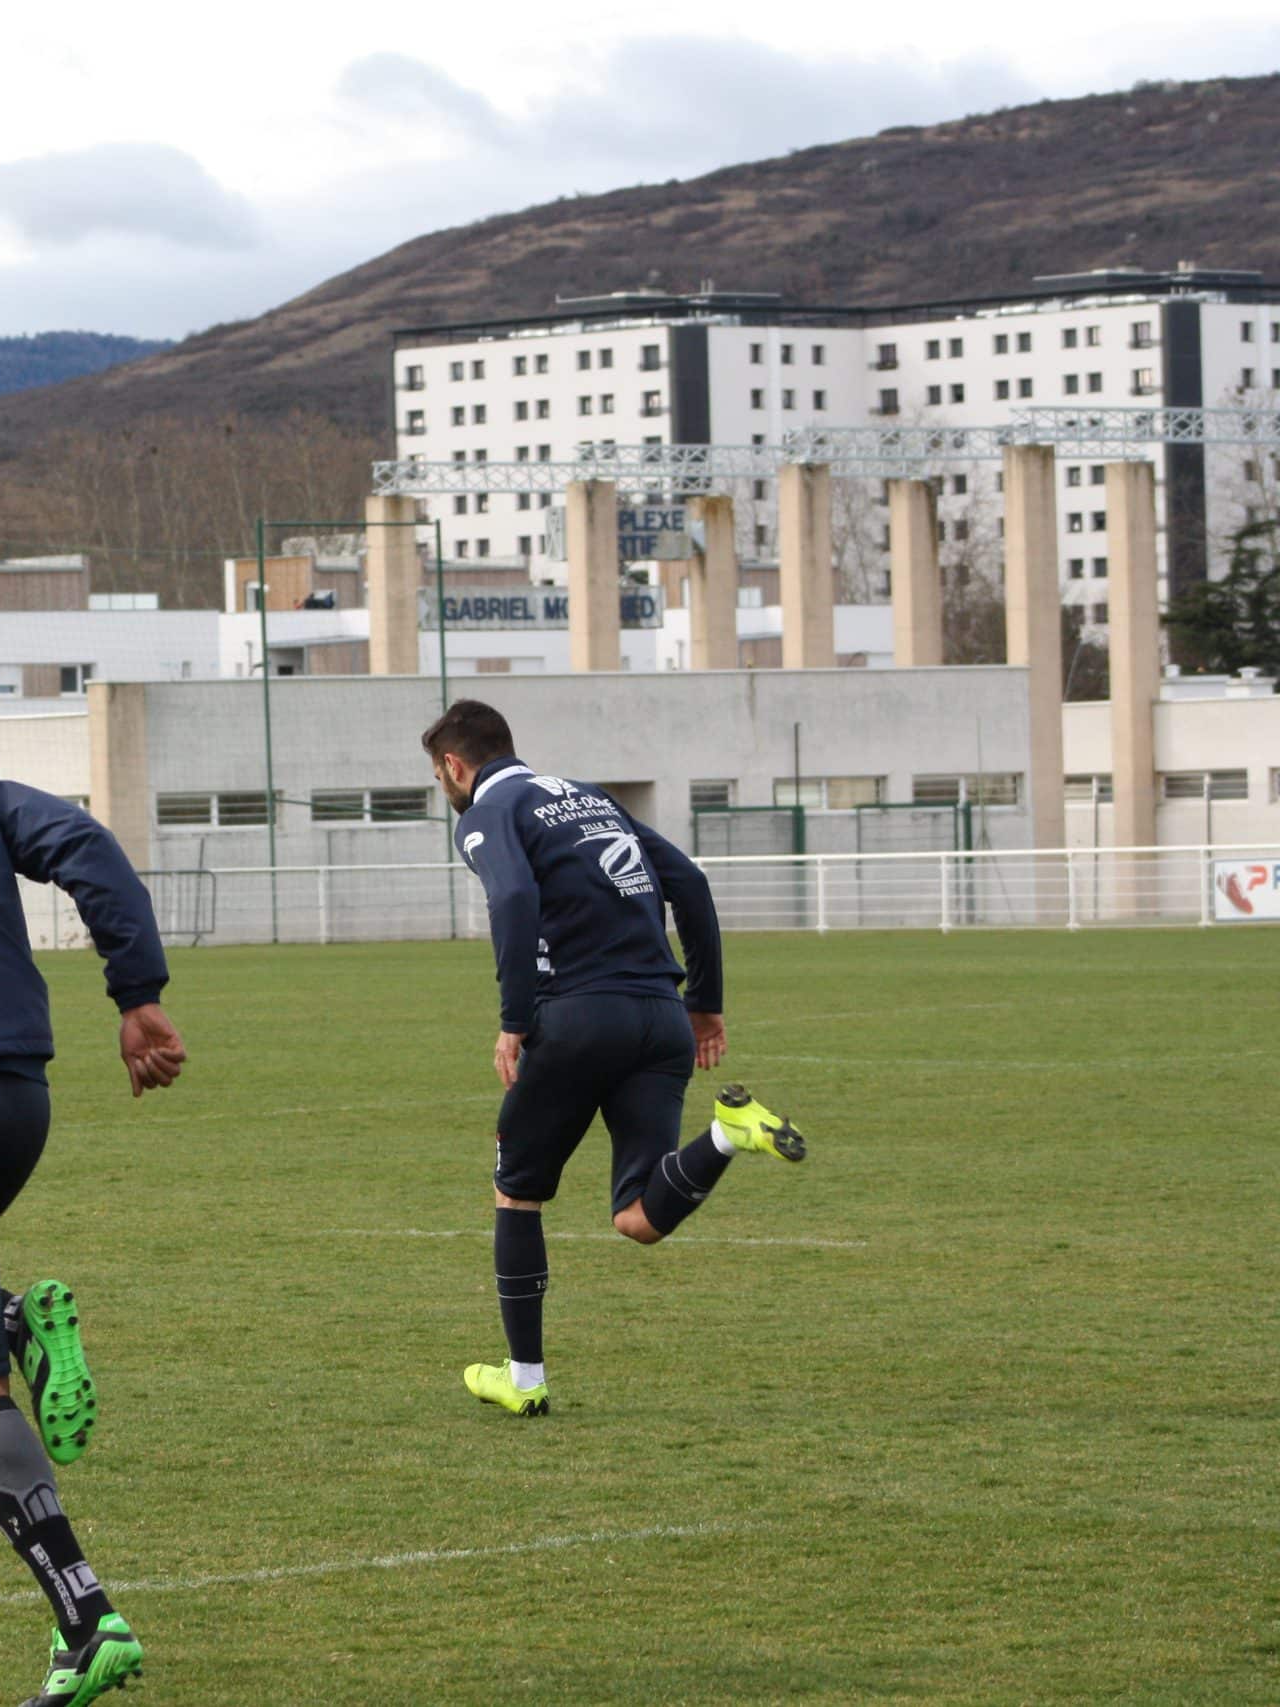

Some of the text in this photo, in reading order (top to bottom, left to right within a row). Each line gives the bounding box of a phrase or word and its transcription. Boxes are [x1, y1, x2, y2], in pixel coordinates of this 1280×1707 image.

[619, 511, 684, 531] PLEXE
[443, 595, 535, 620] GABRIEL
[544, 817, 558, 828] LE
[579, 821, 605, 832] VILLE
